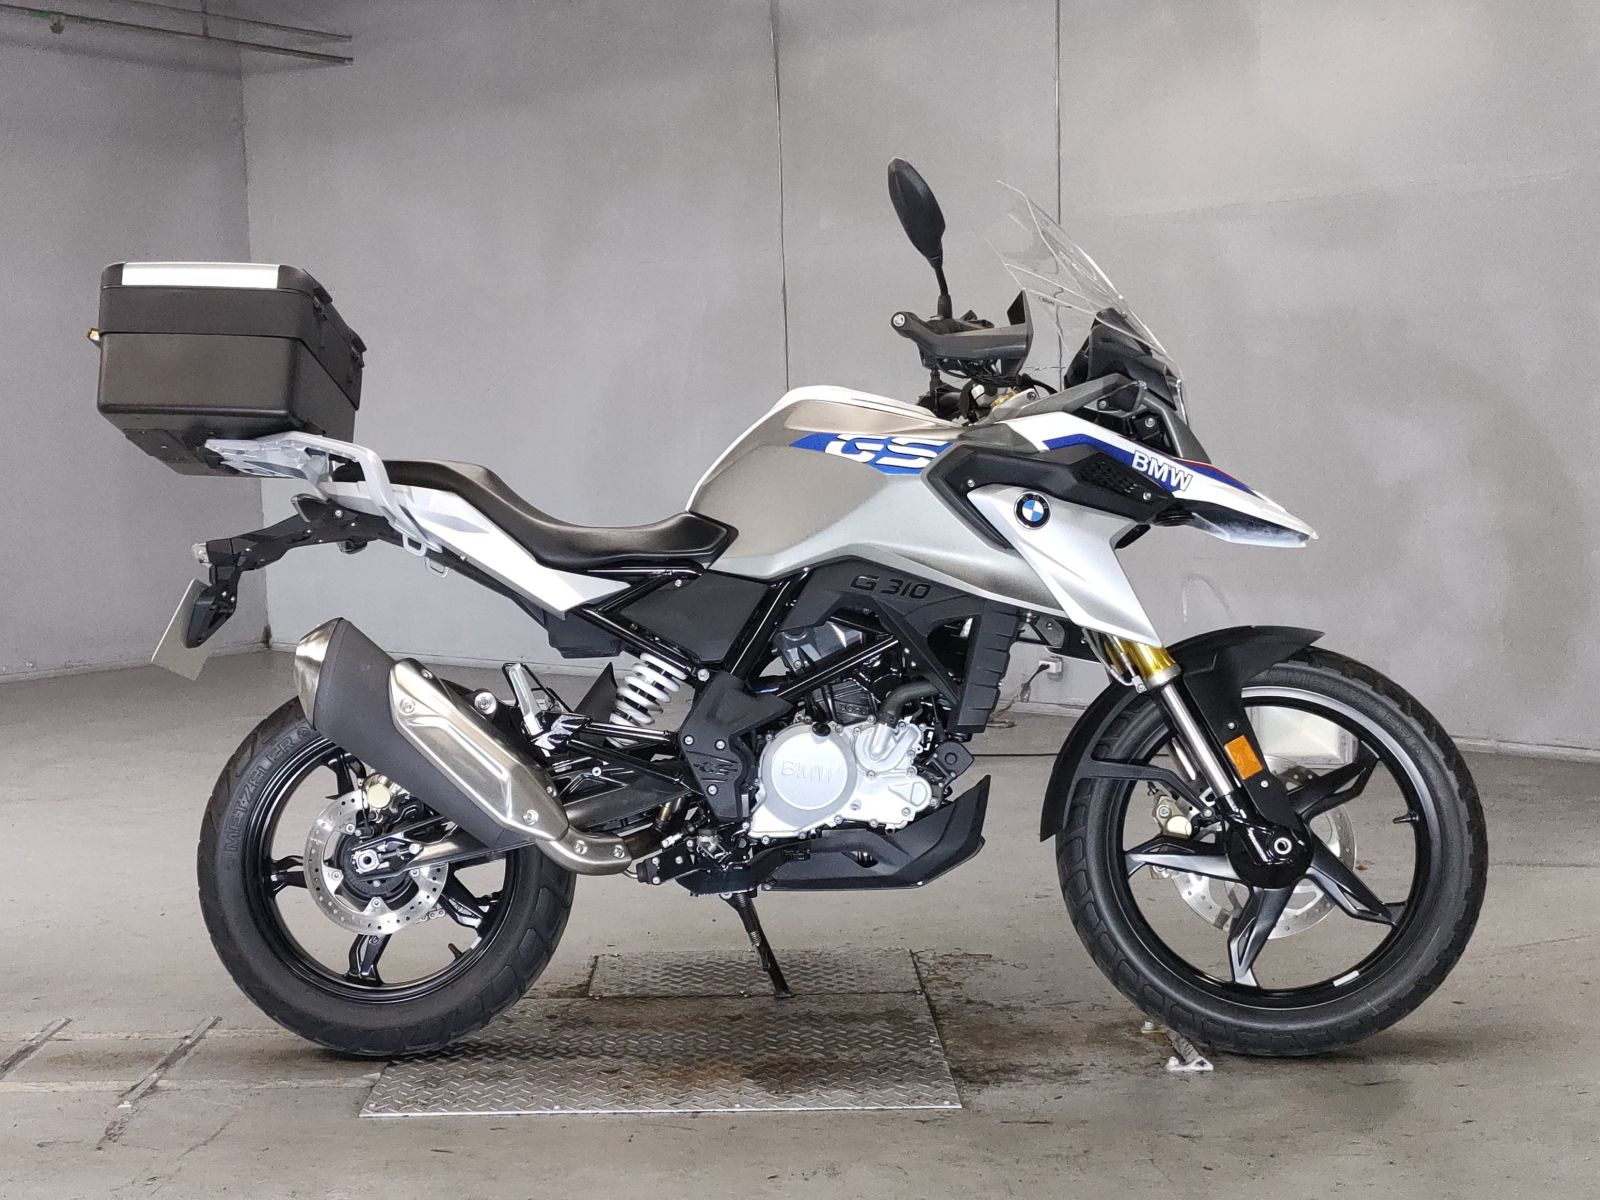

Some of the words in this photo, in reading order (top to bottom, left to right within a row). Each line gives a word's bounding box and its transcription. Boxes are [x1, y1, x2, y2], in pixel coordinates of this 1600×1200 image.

[825, 434, 948, 467] GS
[1131, 450, 1194, 493] BMW
[850, 574, 881, 592] G
[880, 578, 932, 600] 310
[223, 735, 296, 854] METZELER
